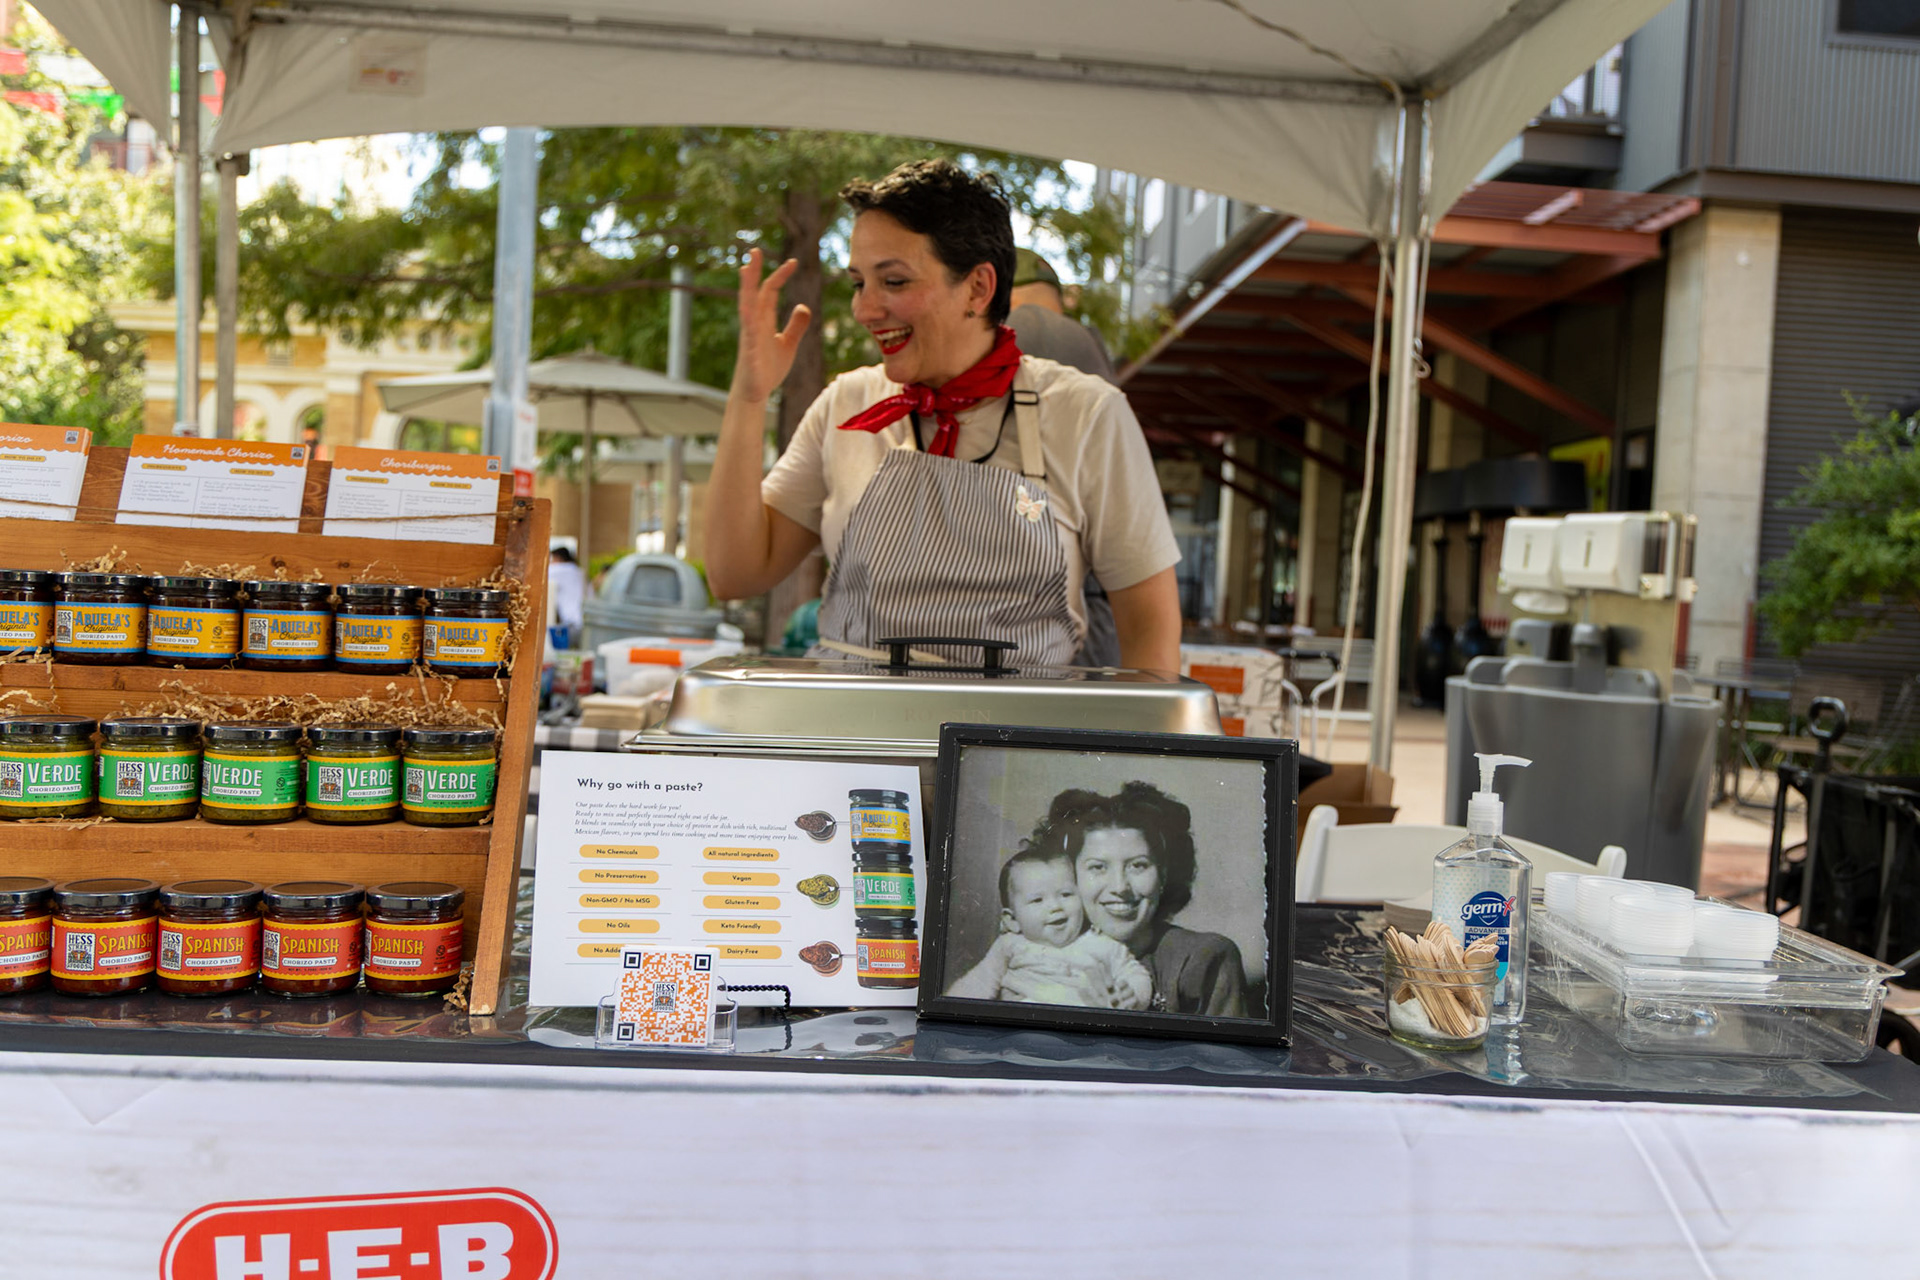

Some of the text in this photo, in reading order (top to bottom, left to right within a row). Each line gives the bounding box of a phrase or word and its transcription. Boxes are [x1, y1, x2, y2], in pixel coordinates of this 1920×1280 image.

[163, 444, 274, 459] Homemade Chorizo
[380, 457, 453, 472] Choriburgers
[75, 611, 130, 627] ABUELA'S
[154, 614, 203, 632] ABUELA'S
[83, 624, 119, 633] Original
[159, 627, 190, 636] Original
[270, 619, 322, 635] ABUELA'S
[344, 622, 393, 639] ABUELA'S
[438, 625, 488, 642] ABUELA'S
[279, 631, 311, 640] Original
[351, 635, 380, 644] Original
[446, 638, 477, 647] Original
[1, 762, 22, 773] HESS
[27, 762, 82, 784] VERDE
[119, 763, 143, 772] HESS
[148, 762, 195, 783] VERDE
[321, 768, 342, 777] HESS
[213, 764, 263, 787] VERDE
[347, 767, 393, 787] VERDE
[427, 770, 477, 790] VERDE
[577, 778, 603, 790] Why
[607, 781, 622, 790] go
[626, 780, 650, 790] with
[665, 782, 703, 792] paste?
[628, 811, 651, 820] perfectly
[703, 813, 710, 821] of
[863, 813, 898, 825] ABUELA'S
[685, 831, 706, 839] cooking
[867, 879, 901, 893] VERDE
[68, 934, 92, 944] HESS
[98, 933, 153, 954] SPANISH
[184, 936, 244, 955] SPANISH
[282, 936, 339, 954] SPANISH
[373, 934, 424, 955] SPANISH
[134, 952, 151, 961] PASTE
[869, 947, 906, 960] SPANISH
[214, 1222, 514, 1280] H-E-B
